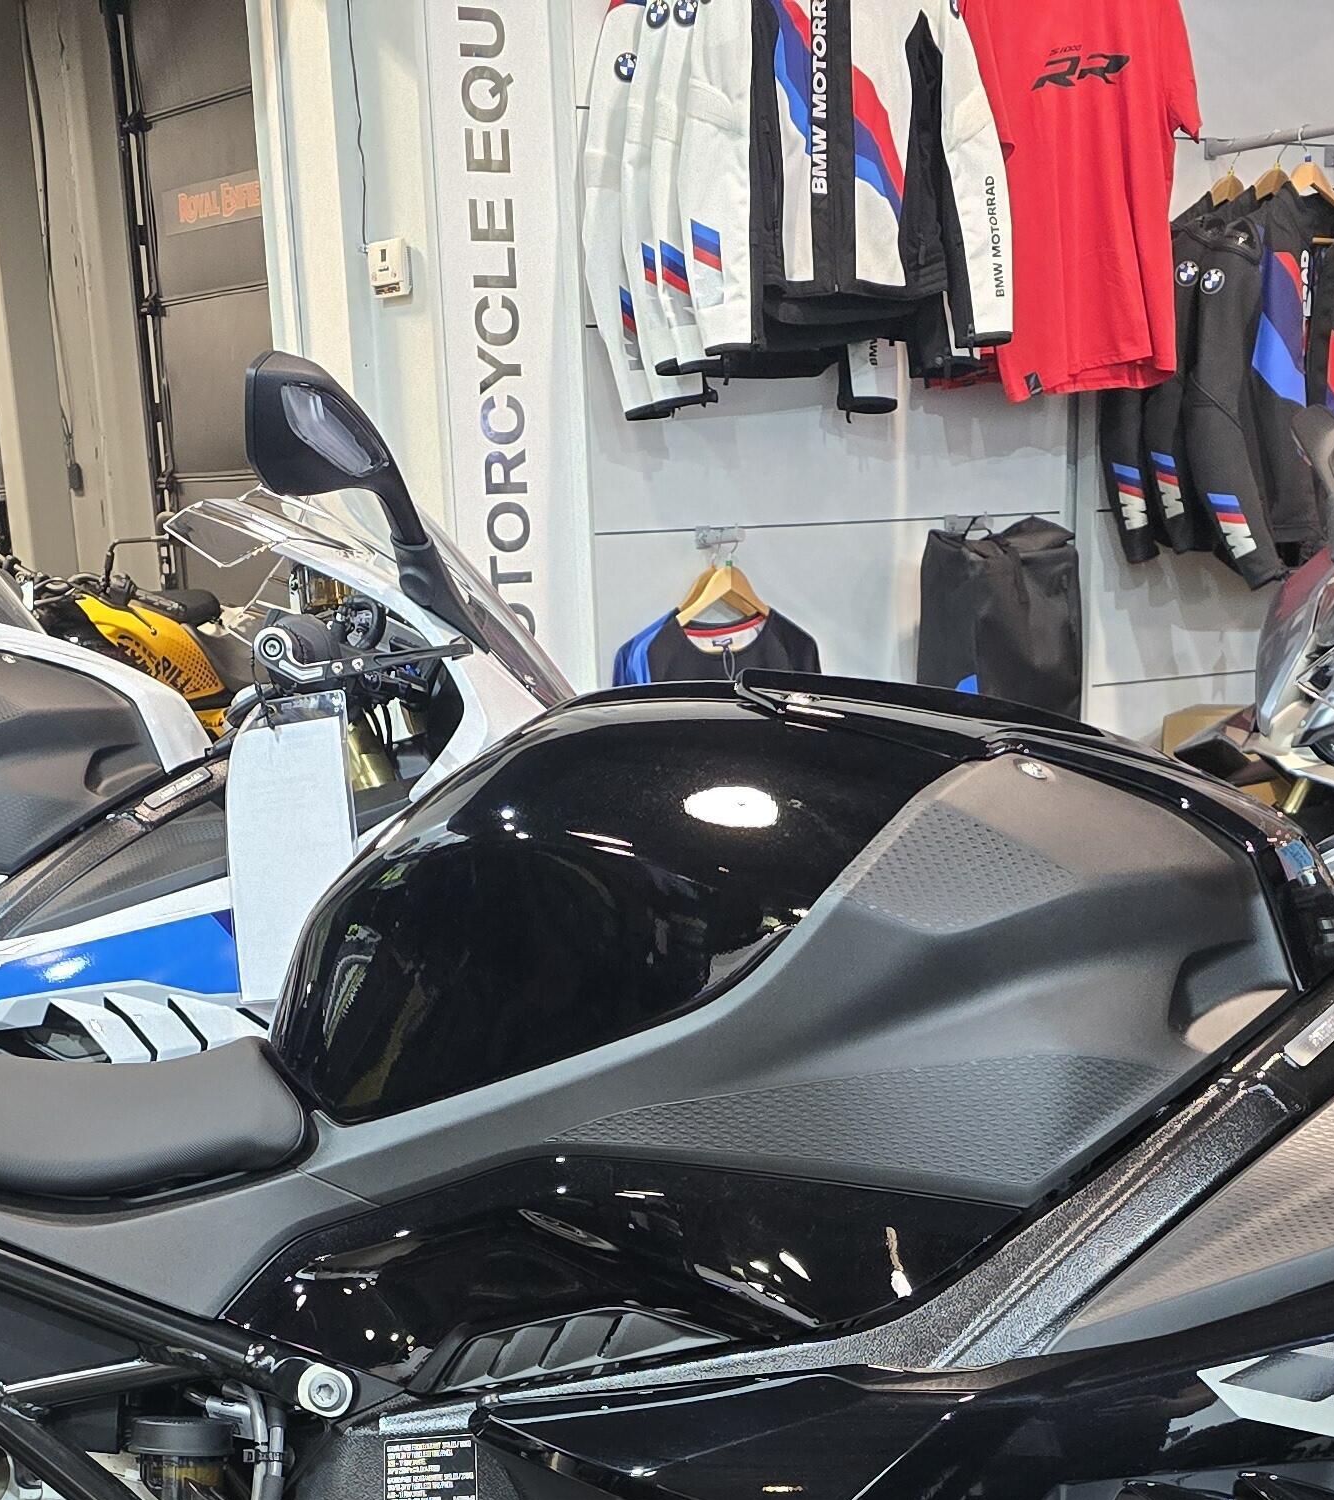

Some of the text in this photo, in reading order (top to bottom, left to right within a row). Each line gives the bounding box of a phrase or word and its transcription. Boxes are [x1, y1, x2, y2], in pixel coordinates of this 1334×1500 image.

[177, 190, 220, 223] ROYAL
[811, 130, 828, 195] BMW
[984, 175, 1005, 298] BMW MOTORRAD
[457, 6, 536, 638] TORCYCLE EQU
